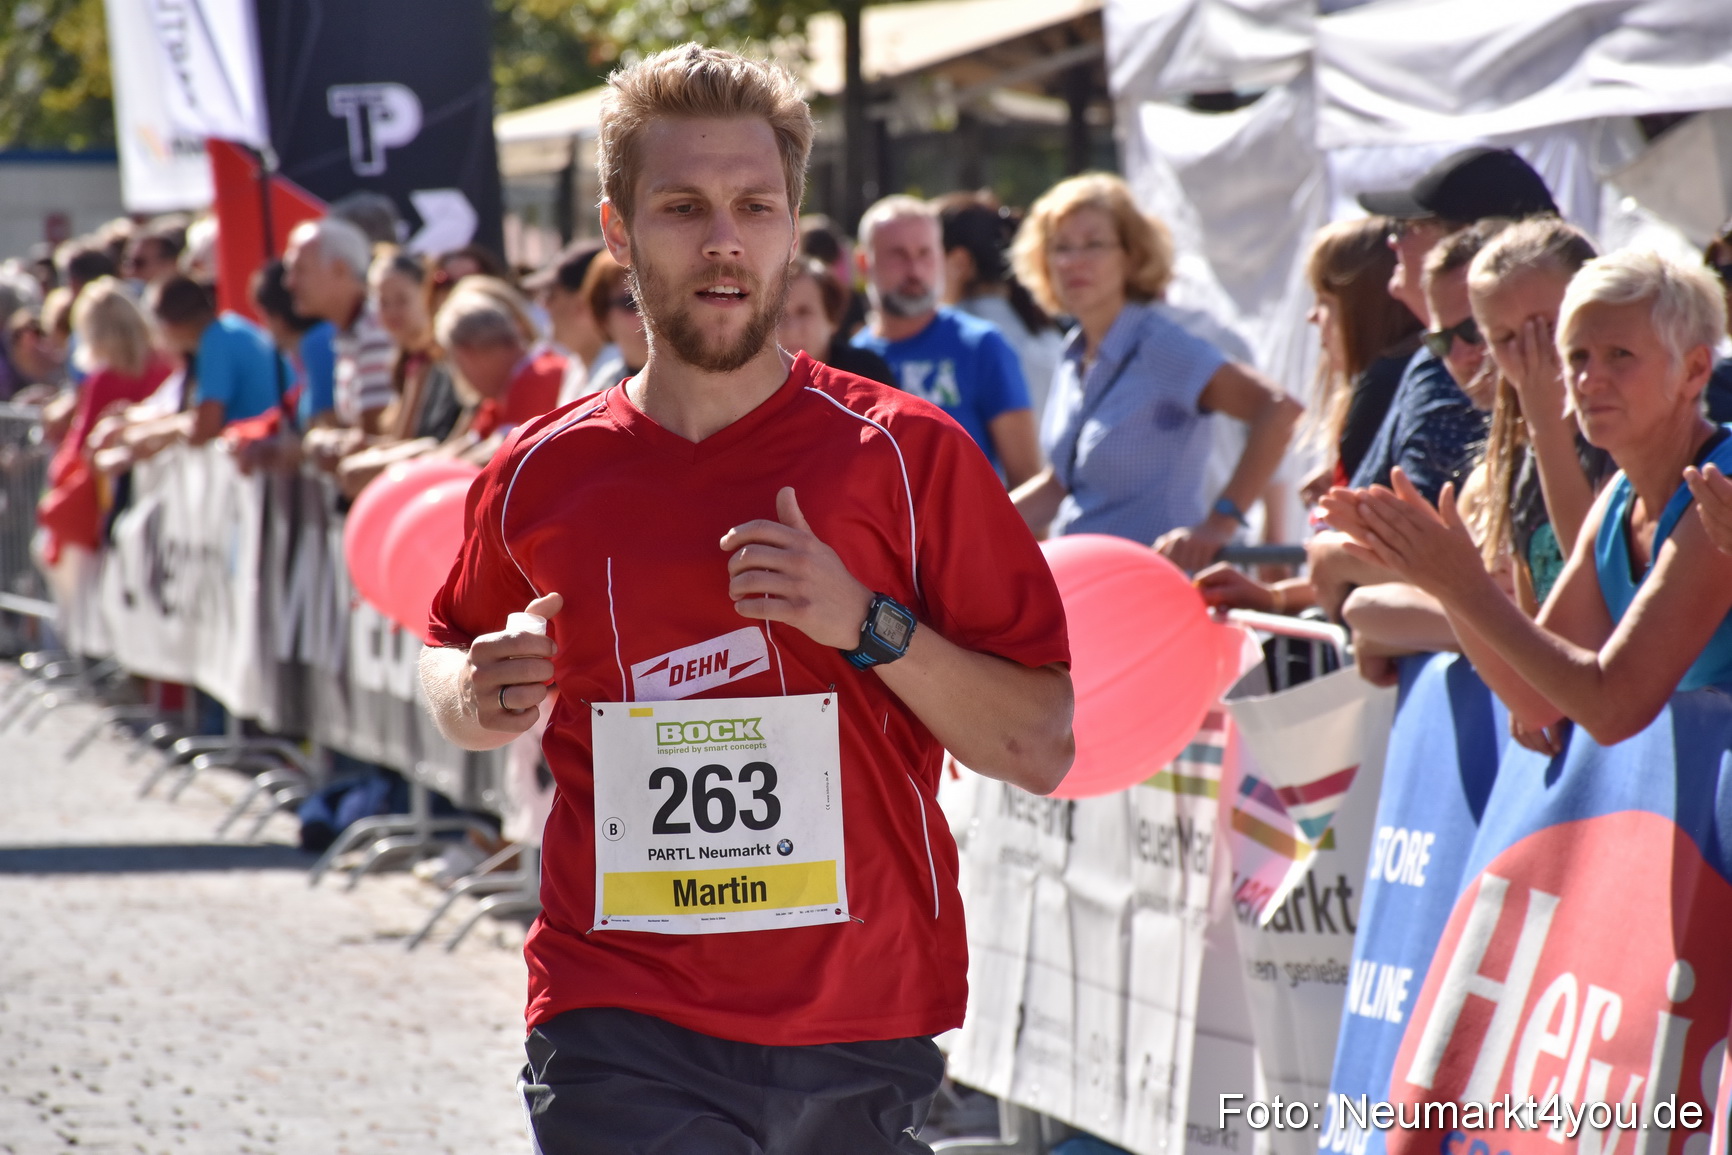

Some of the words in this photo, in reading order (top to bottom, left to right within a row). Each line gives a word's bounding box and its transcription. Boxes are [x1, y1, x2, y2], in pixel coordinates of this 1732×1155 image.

[668, 648, 730, 688] DEHN
[656, 717, 765, 746] BOCK
[657, 746, 690, 756] inspired
[691, 745, 702, 754] by
[703, 743, 728, 752] smart
[729, 741, 767, 752] concepts
[648, 761, 782, 835] 263
[609, 823, 618, 836] B
[648, 847, 695, 861] PARTL
[699, 843, 772, 860] Neumarkt
[672, 875, 768, 908] Martin
